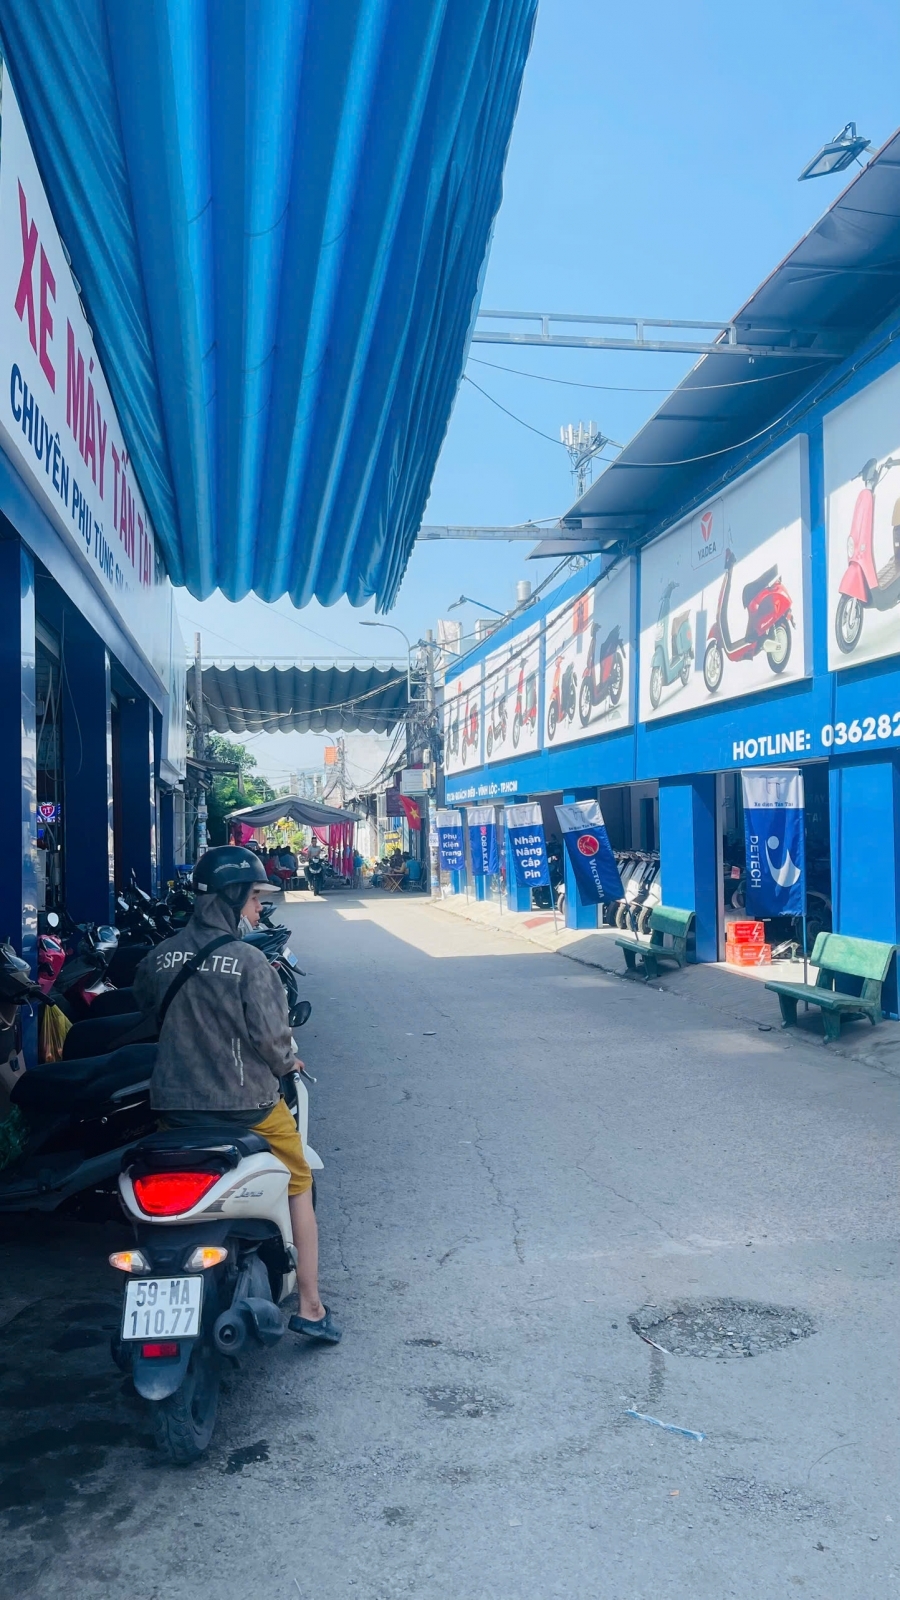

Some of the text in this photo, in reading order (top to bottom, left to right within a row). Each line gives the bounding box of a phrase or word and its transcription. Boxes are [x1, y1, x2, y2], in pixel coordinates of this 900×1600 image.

[14, 176, 57, 395] XE
[66, 316, 107, 501] MÁY
[10, 363, 70, 508] CHUYÊN
[71, 478, 92, 554] PHỤ
[93, 520, 114, 584] TÙNG
[697, 541, 717, 561] YADEA
[732, 729, 811, 761] HOTLINE:
[443, 833, 457, 841] Phụ
[514, 835, 541, 846] Nhận
[441, 850, 462, 858] Trang
[516, 847, 542, 857] Nâng
[521, 857, 540, 869] Cấp
[749, 835, 762, 888] DETECH
[524, 870, 541, 879] Pin
[588, 858, 605, 898] VICTORIA
[136, 1281, 190, 1307] 59-MA
[130, 1308, 195, 1337] 110.77
